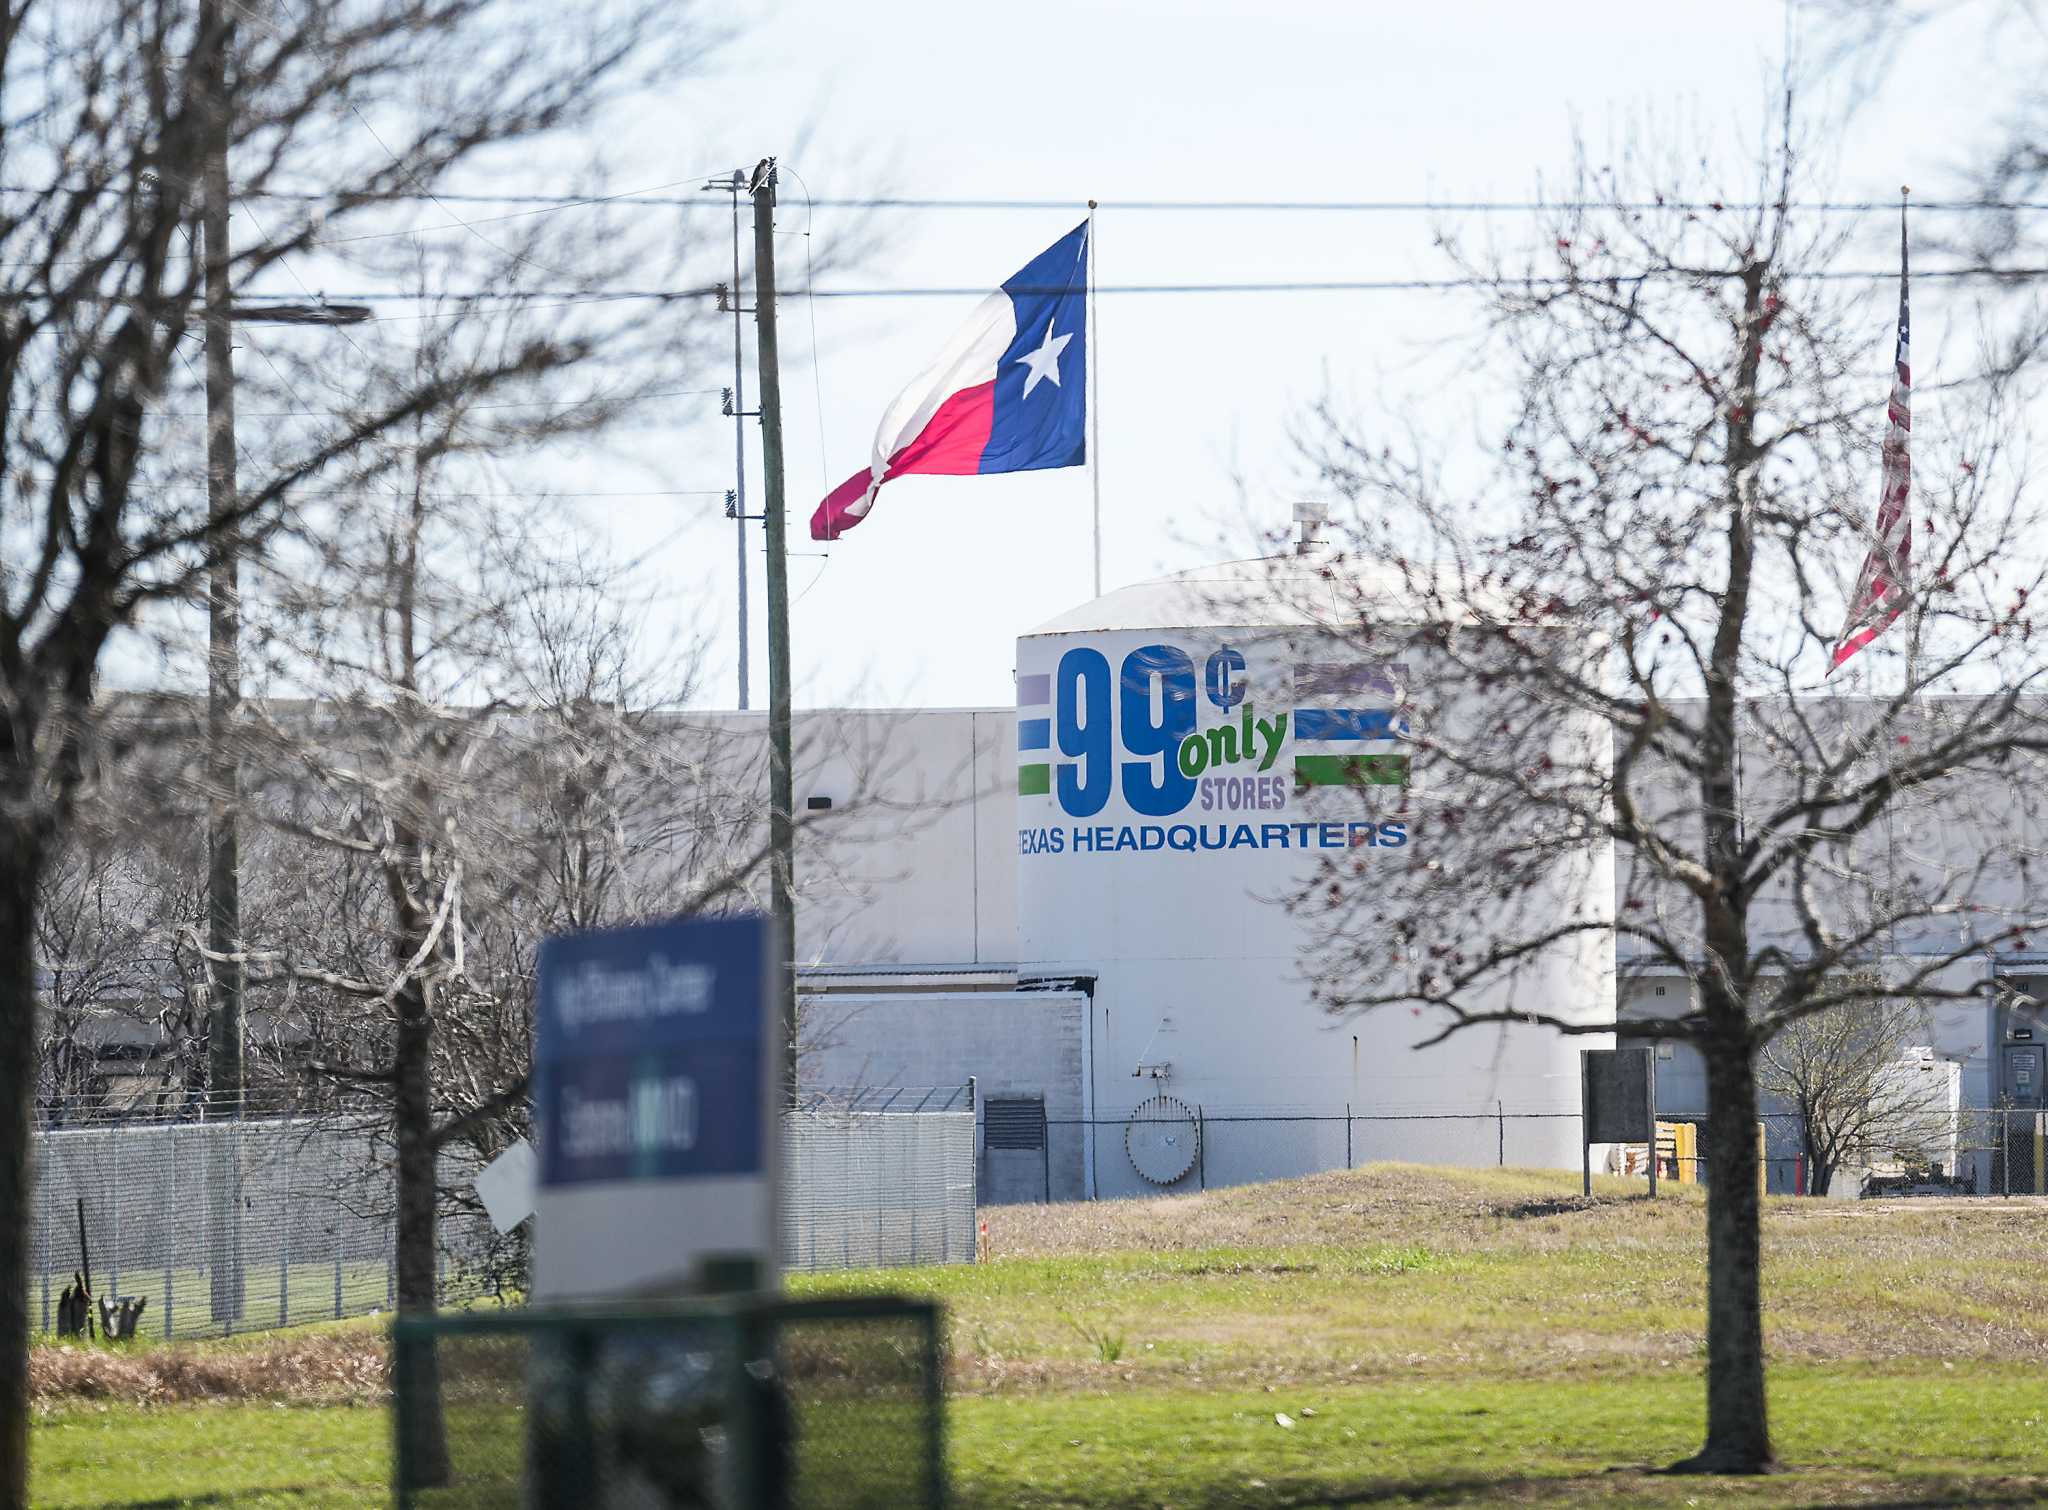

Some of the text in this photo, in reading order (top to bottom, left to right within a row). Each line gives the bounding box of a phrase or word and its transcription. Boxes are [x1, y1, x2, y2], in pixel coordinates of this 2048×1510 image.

[1181, 704, 1287, 778] only
[1200, 777, 1286, 811] STORES
[1073, 822, 1408, 852] HEADQUARTERS
